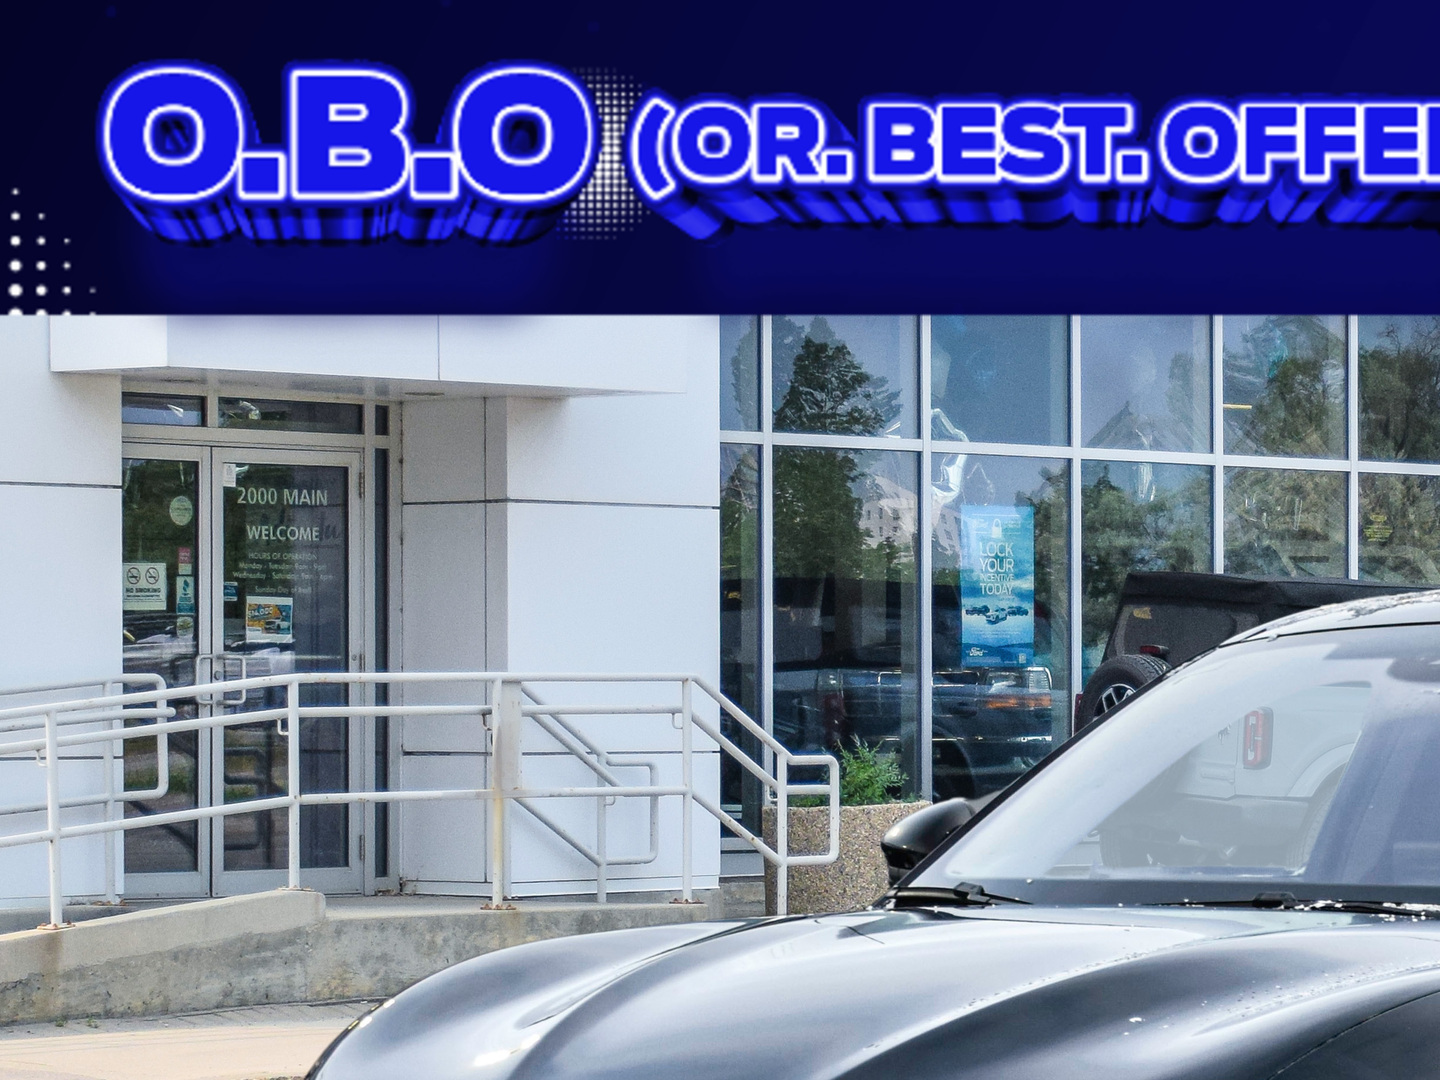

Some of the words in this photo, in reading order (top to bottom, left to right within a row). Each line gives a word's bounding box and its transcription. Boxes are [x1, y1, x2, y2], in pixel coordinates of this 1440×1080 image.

[237, 487, 277, 505] 2000
[284, 488, 328, 506] MAIN
[246, 525, 320, 541] WELCOME
[248, 552, 271, 560] HOURS
[980, 541, 1014, 557] LOCK
[980, 558, 1014, 572] YOUR
[980, 583, 1013, 595] TODAY
